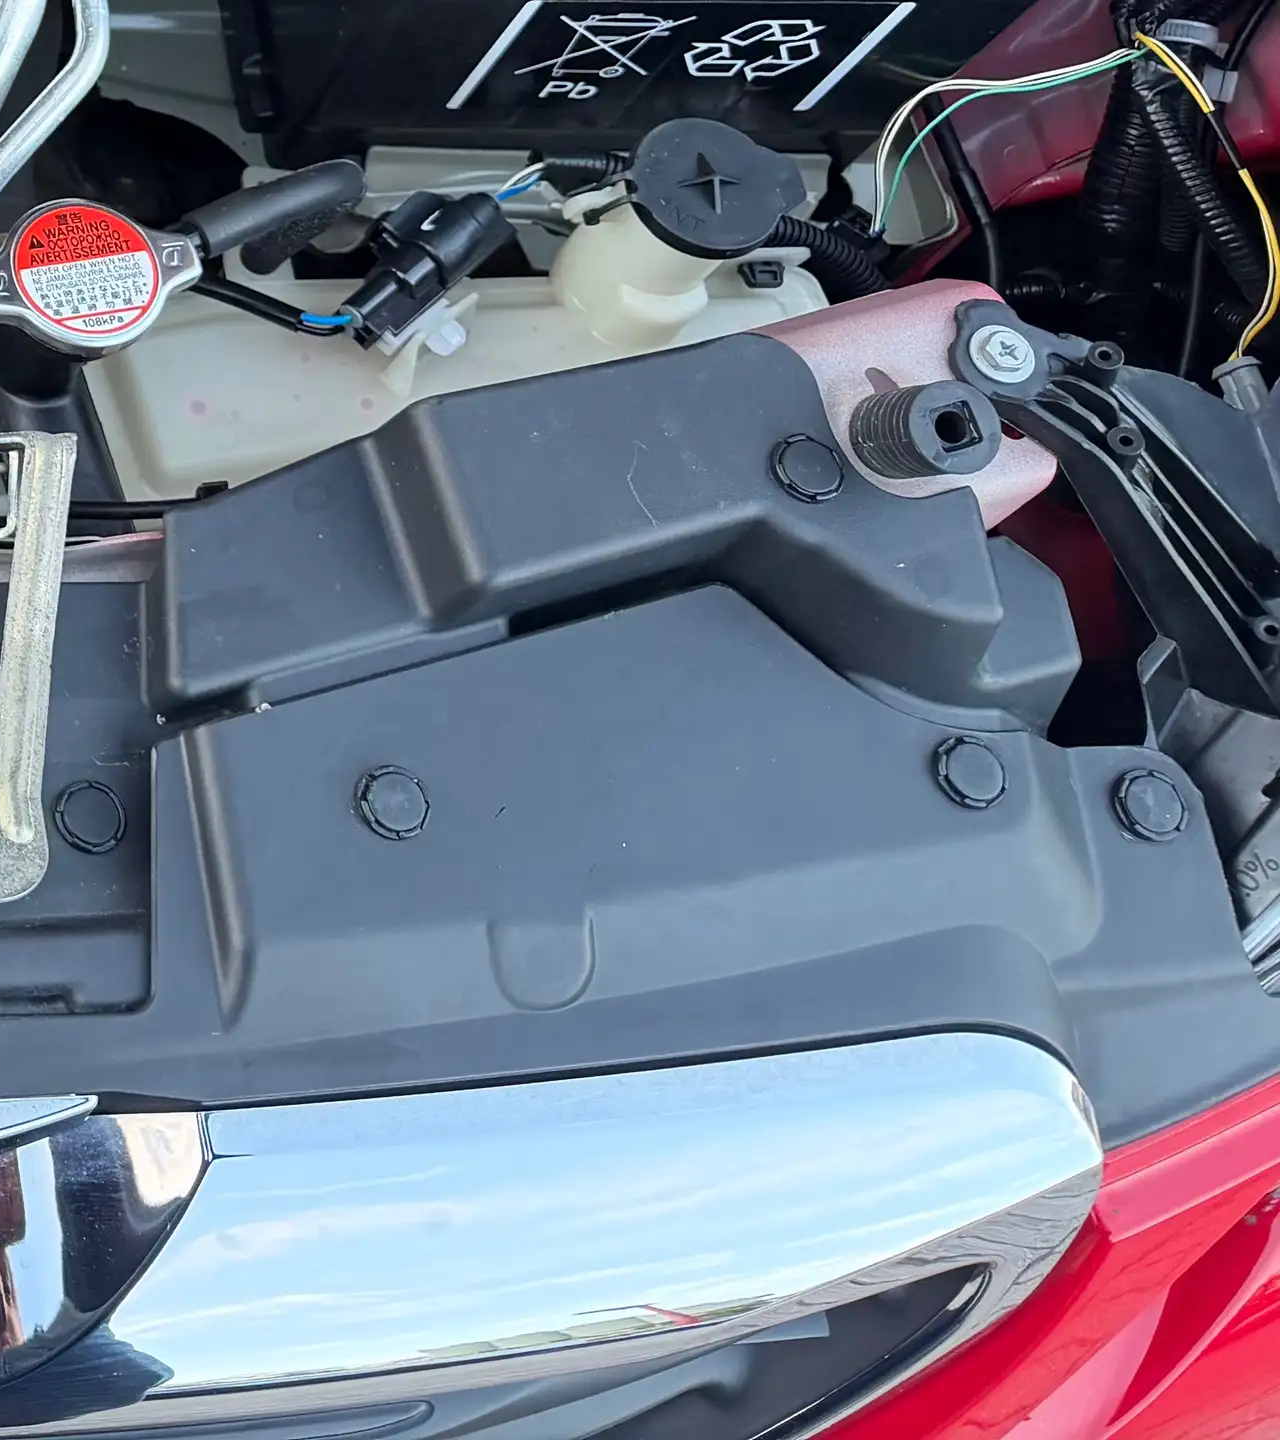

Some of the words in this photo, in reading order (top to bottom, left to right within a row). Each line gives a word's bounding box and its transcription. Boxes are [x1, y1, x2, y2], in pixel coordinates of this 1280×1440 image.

[538, 81, 598, 100] Pb
[54, 212, 82, 227] 警告
[43, 220, 110, 240] WARNING
[47, 230, 121, 251] ОСТОРОЖНО
[30, 240, 132, 266] AVERTISSEMENT
[30, 267, 59, 278] NEVER
[62, 263, 86, 273] OPEN
[88, 258, 116, 270] WHEN
[118, 254, 140, 264] HOT.
[46, 273, 74, 284] JAMAIS
[74, 268, 104, 279] OUVRIR
[34, 286, 45, 294] НЕ
[82, 315, 124, 328] 108kPa
